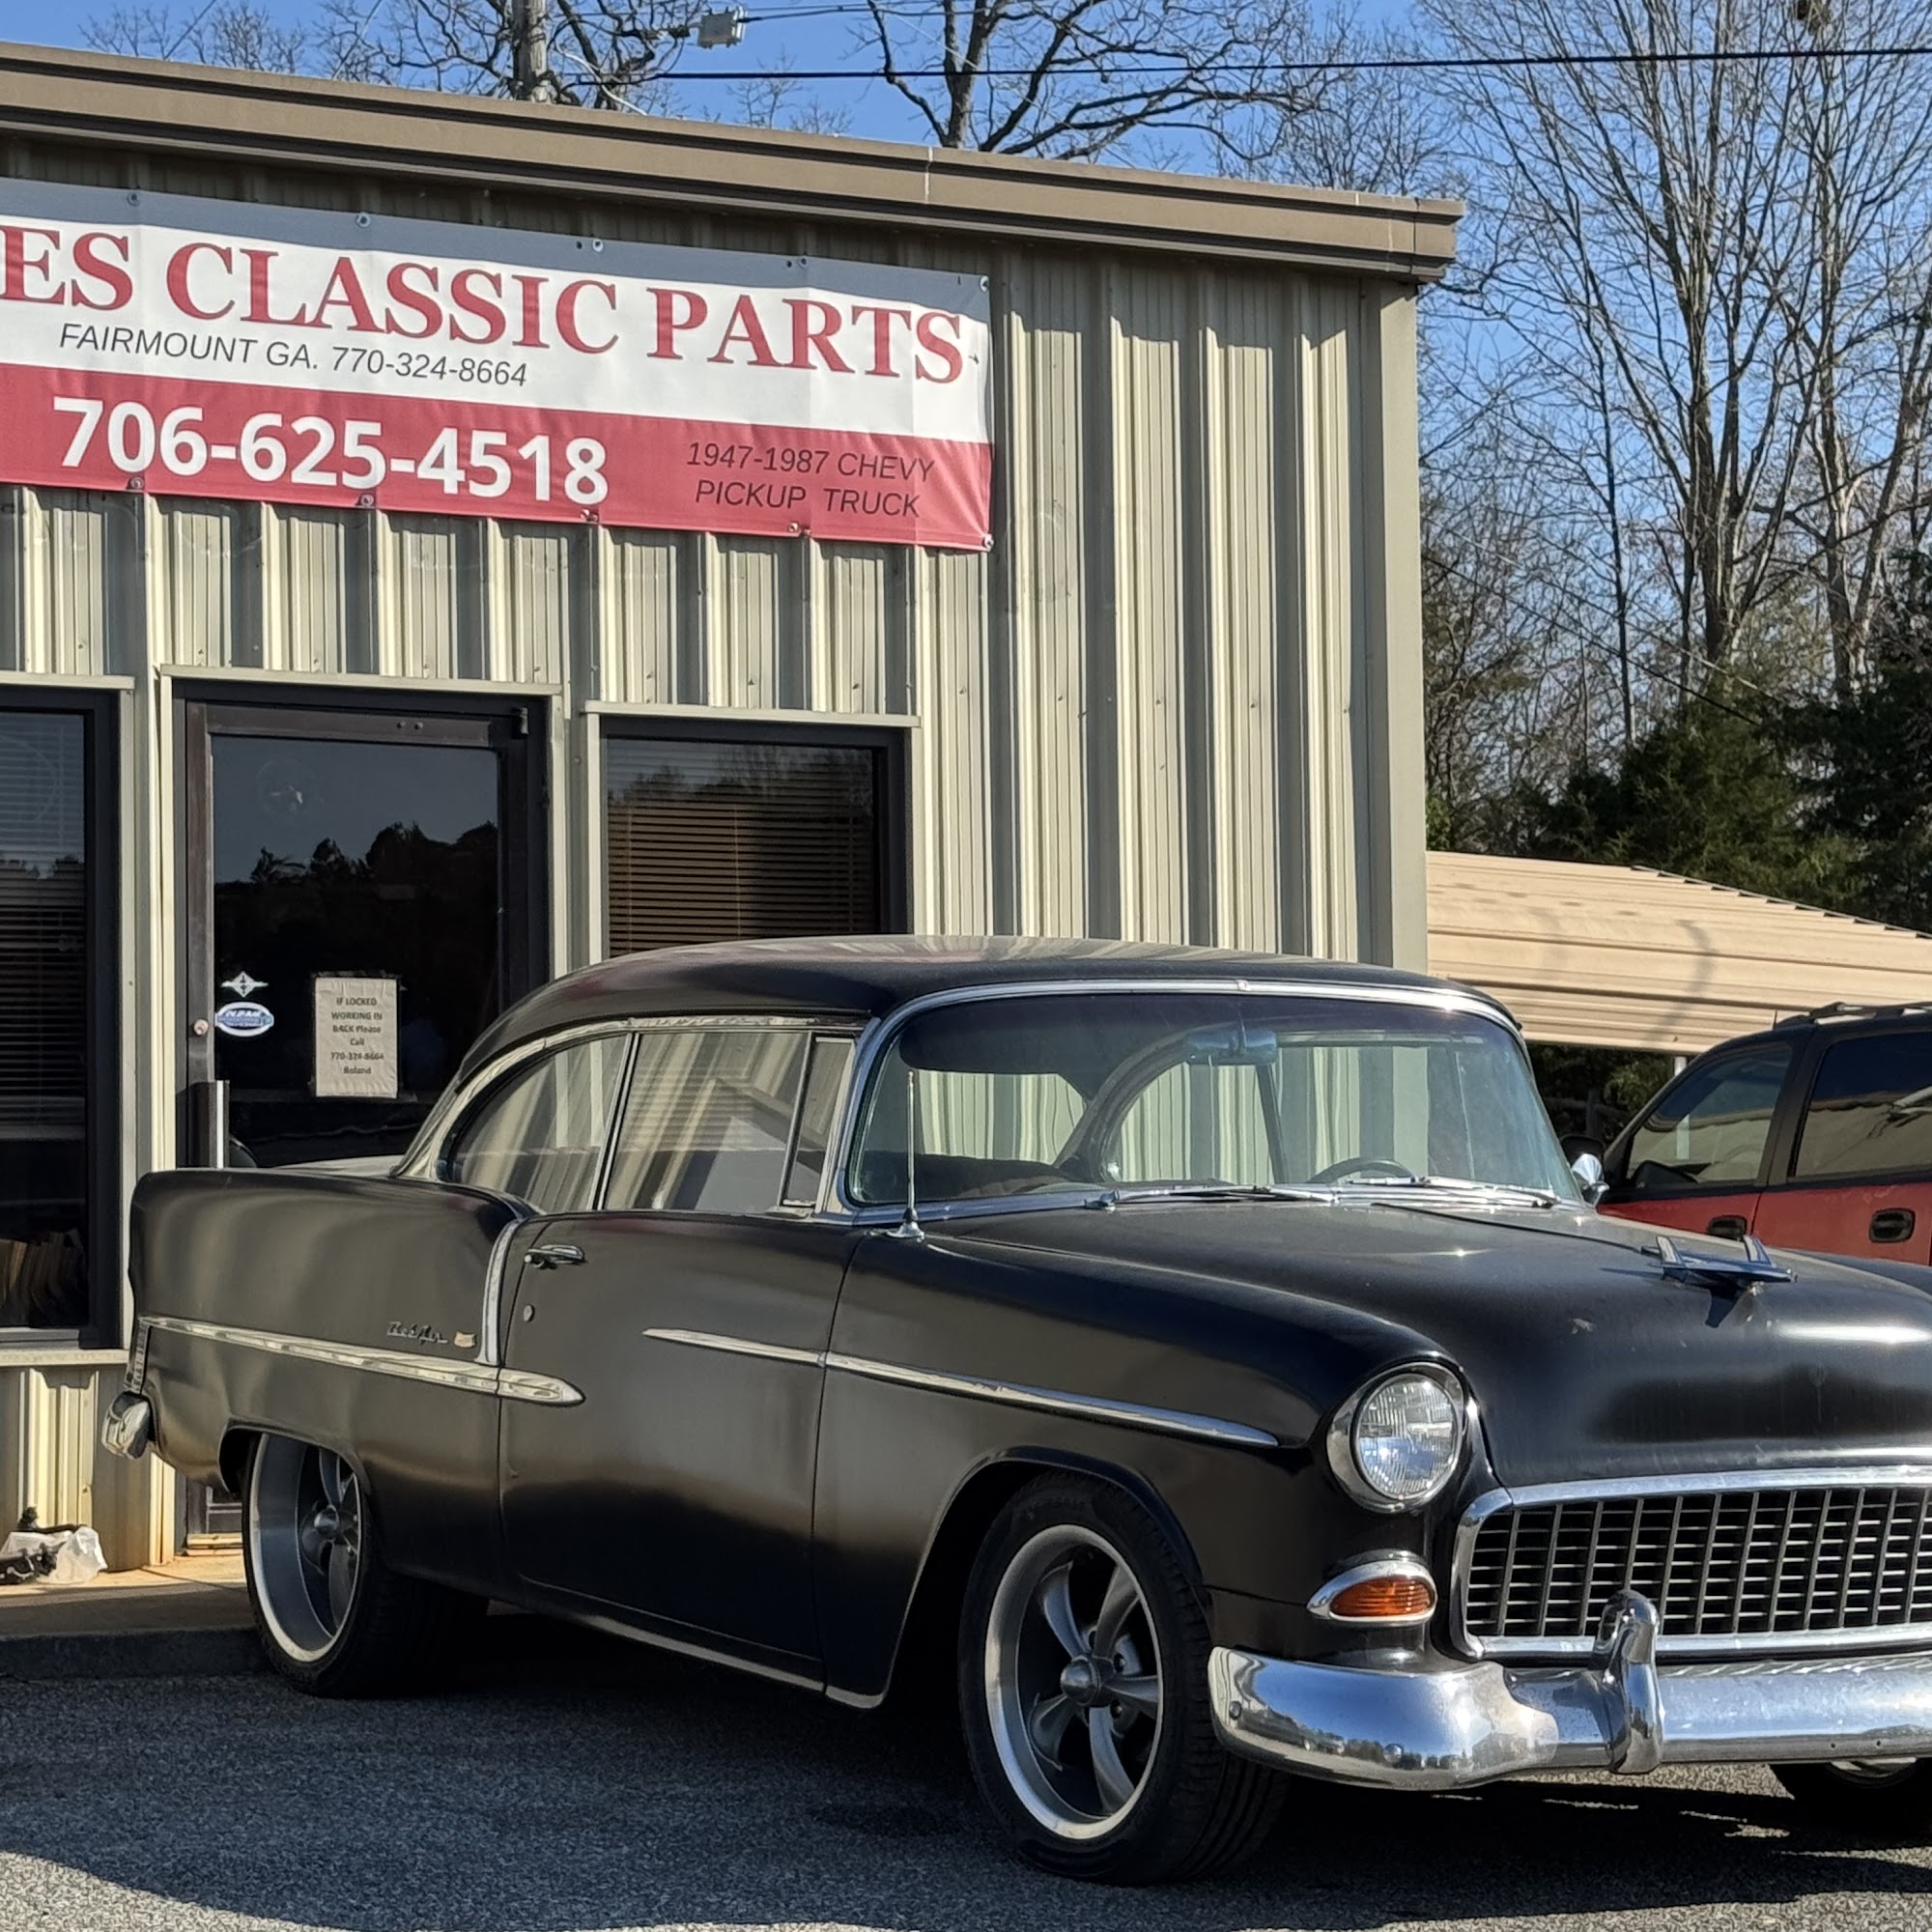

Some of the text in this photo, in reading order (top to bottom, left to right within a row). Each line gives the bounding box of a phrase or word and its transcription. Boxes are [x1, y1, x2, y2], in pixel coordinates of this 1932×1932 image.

[165, 242, 619, 355] CLASSIC
[646, 287, 964, 384] PARTS
[60, 323, 527, 387] FAIRMOUNT GA. 770-324-8664
[53, 396, 609, 506] 706-625-4518
[687, 441, 935, 482] 1947-1987 CHEVY
[695, 479, 922, 519] PICKUP TRUCK
[331, 1011, 372, 1020] WORKING
